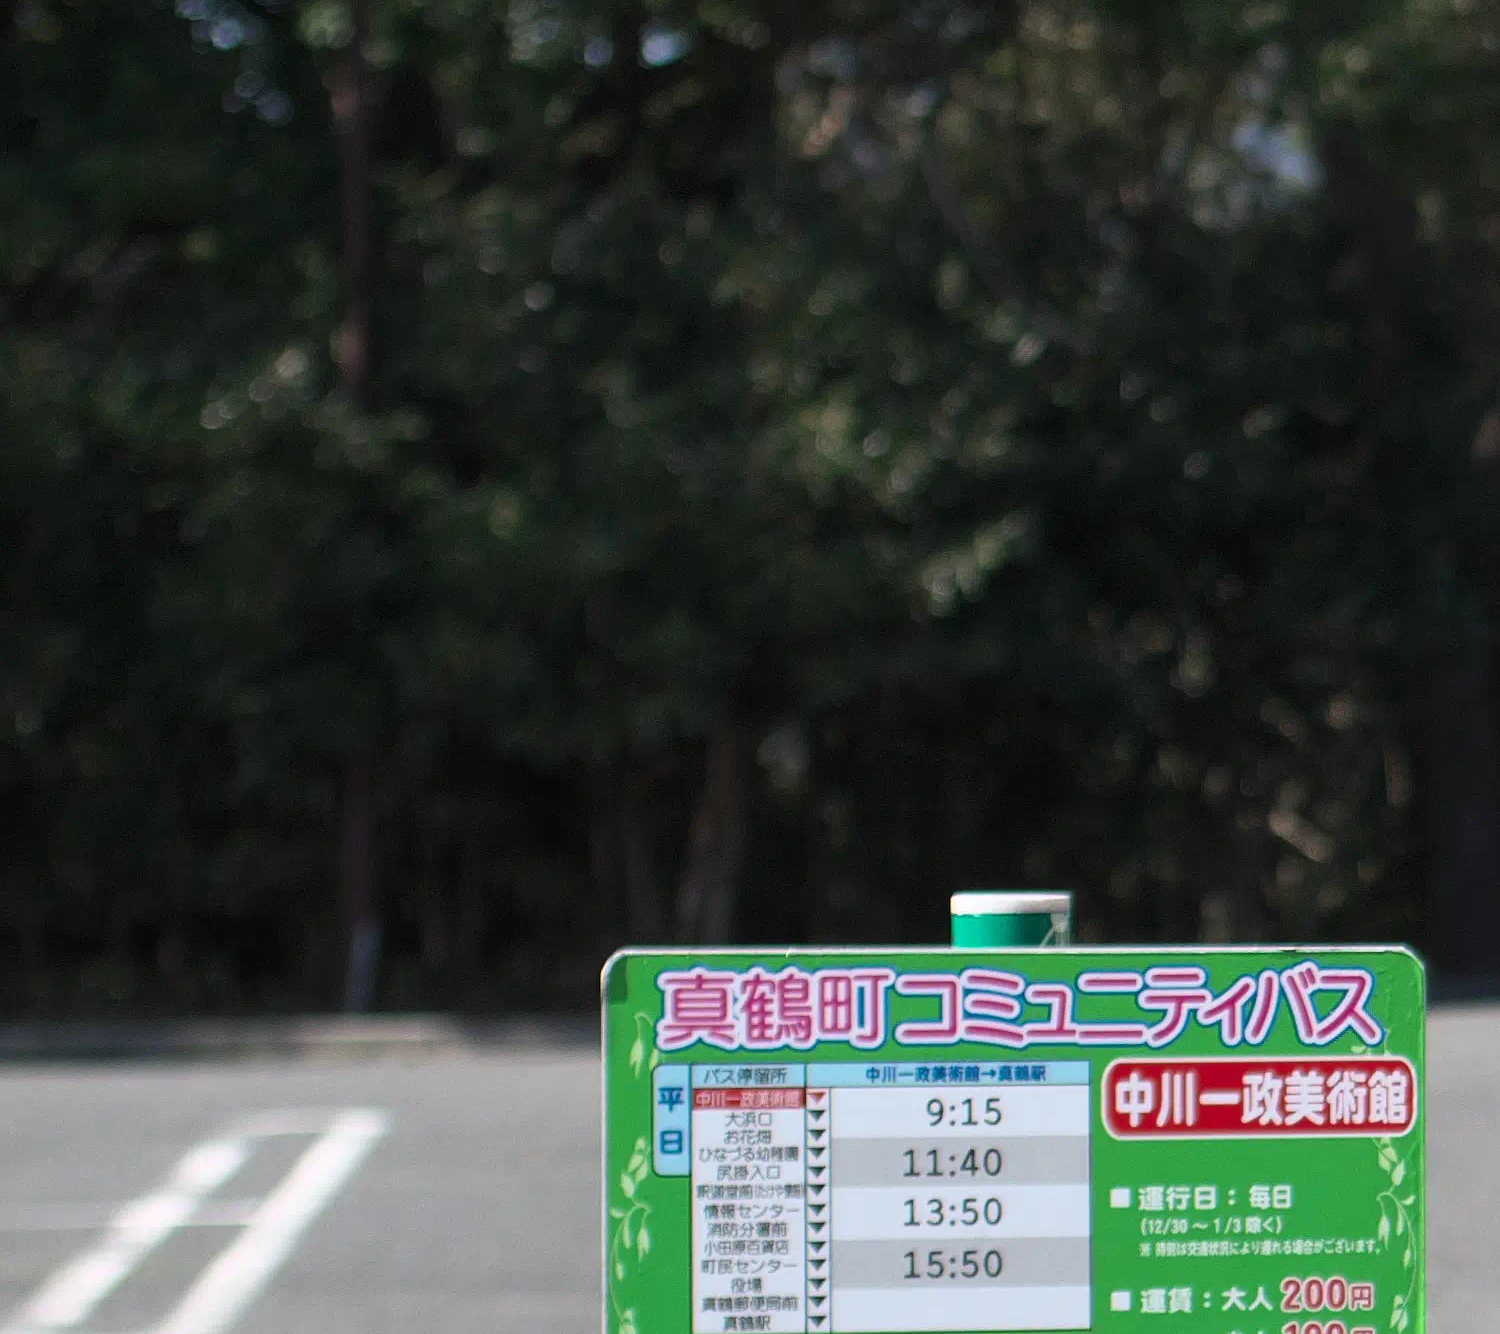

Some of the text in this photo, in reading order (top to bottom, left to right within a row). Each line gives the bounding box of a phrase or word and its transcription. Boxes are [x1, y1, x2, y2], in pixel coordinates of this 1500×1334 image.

[657, 961, 1385, 1052] 真鶴町コミュニティバス
[704, 1068, 787, 1084] バス停留所
[696, 1091, 800, 1107] 中川一政美術館
[1115, 1069, 1408, 1127] 中川一政美術館
[927, 1097, 1001, 1126] 9:15
[725, 1113, 772, 1127] 大浜口
[724, 1130, 771, 1144] お花畑
[699, 1147, 798, 1163] ひなづる幼稚園
[903, 1149, 1001, 1177] 11:40
[705, 1204, 798, 1219] 情報センター
[903, 1198, 1002, 1226] 13:50
[702, 1259, 796, 1274] 町民センター
[903, 1250, 1002, 1278] 15:50
[724, 1316, 770, 1331] 真鶴駅
